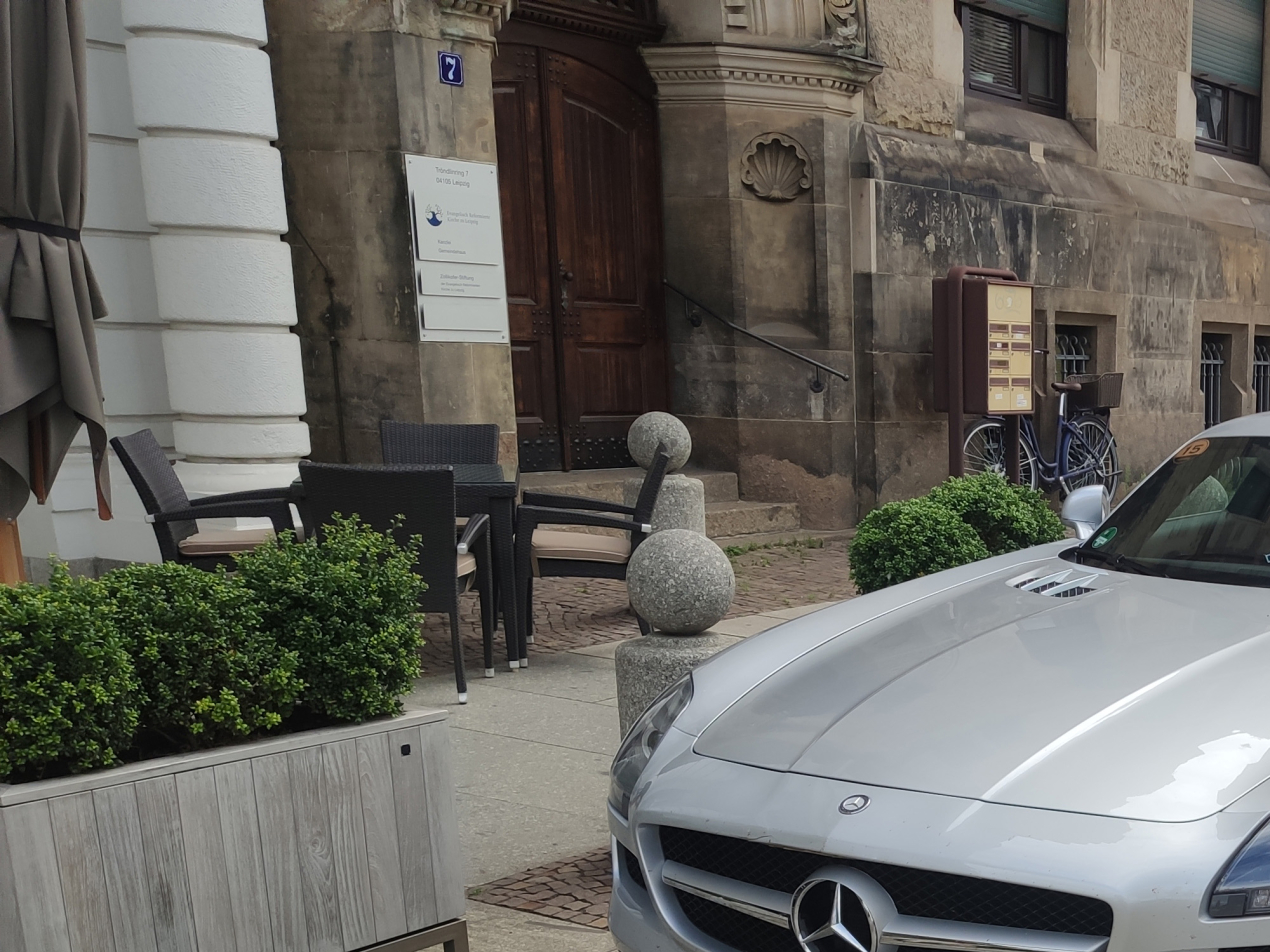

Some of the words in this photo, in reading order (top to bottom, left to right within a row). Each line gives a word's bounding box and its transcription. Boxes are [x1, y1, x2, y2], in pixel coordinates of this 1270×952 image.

[445, 56, 456, 80] 7
[435, 166, 465, 177] Tröndlinring
[436, 177, 451, 185] 04105
[452, 179, 470, 188] Leipzig
[1182, 444, 1204, 456] 15
